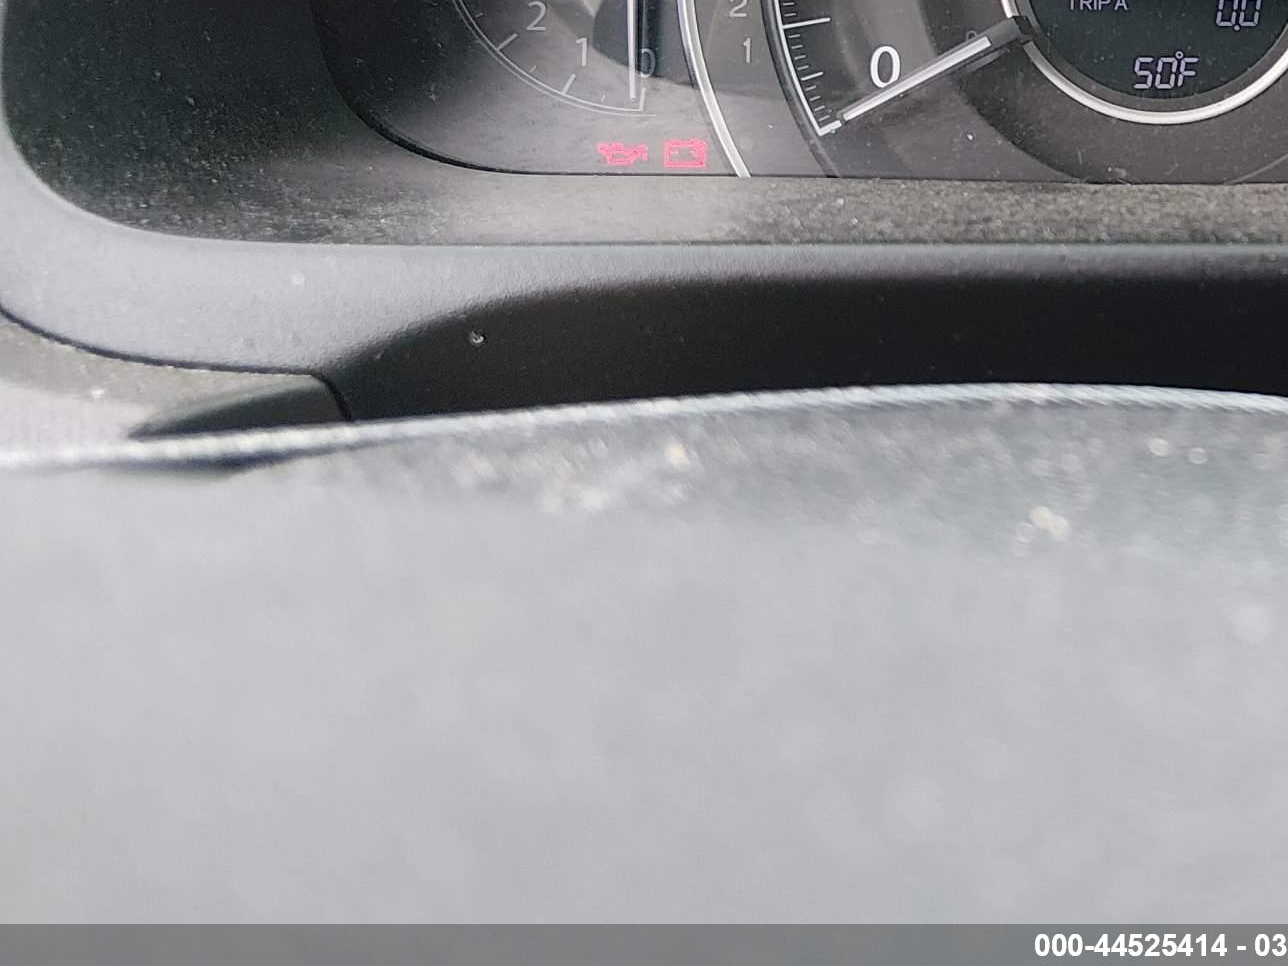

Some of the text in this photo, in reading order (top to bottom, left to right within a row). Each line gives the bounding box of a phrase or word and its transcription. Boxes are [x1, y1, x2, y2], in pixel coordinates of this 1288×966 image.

[527, 1, 547, 31] 2
[576, 36, 588, 67] 1
[742, 38, 752, 63] 1
[869, 46, 901, 88] 0
